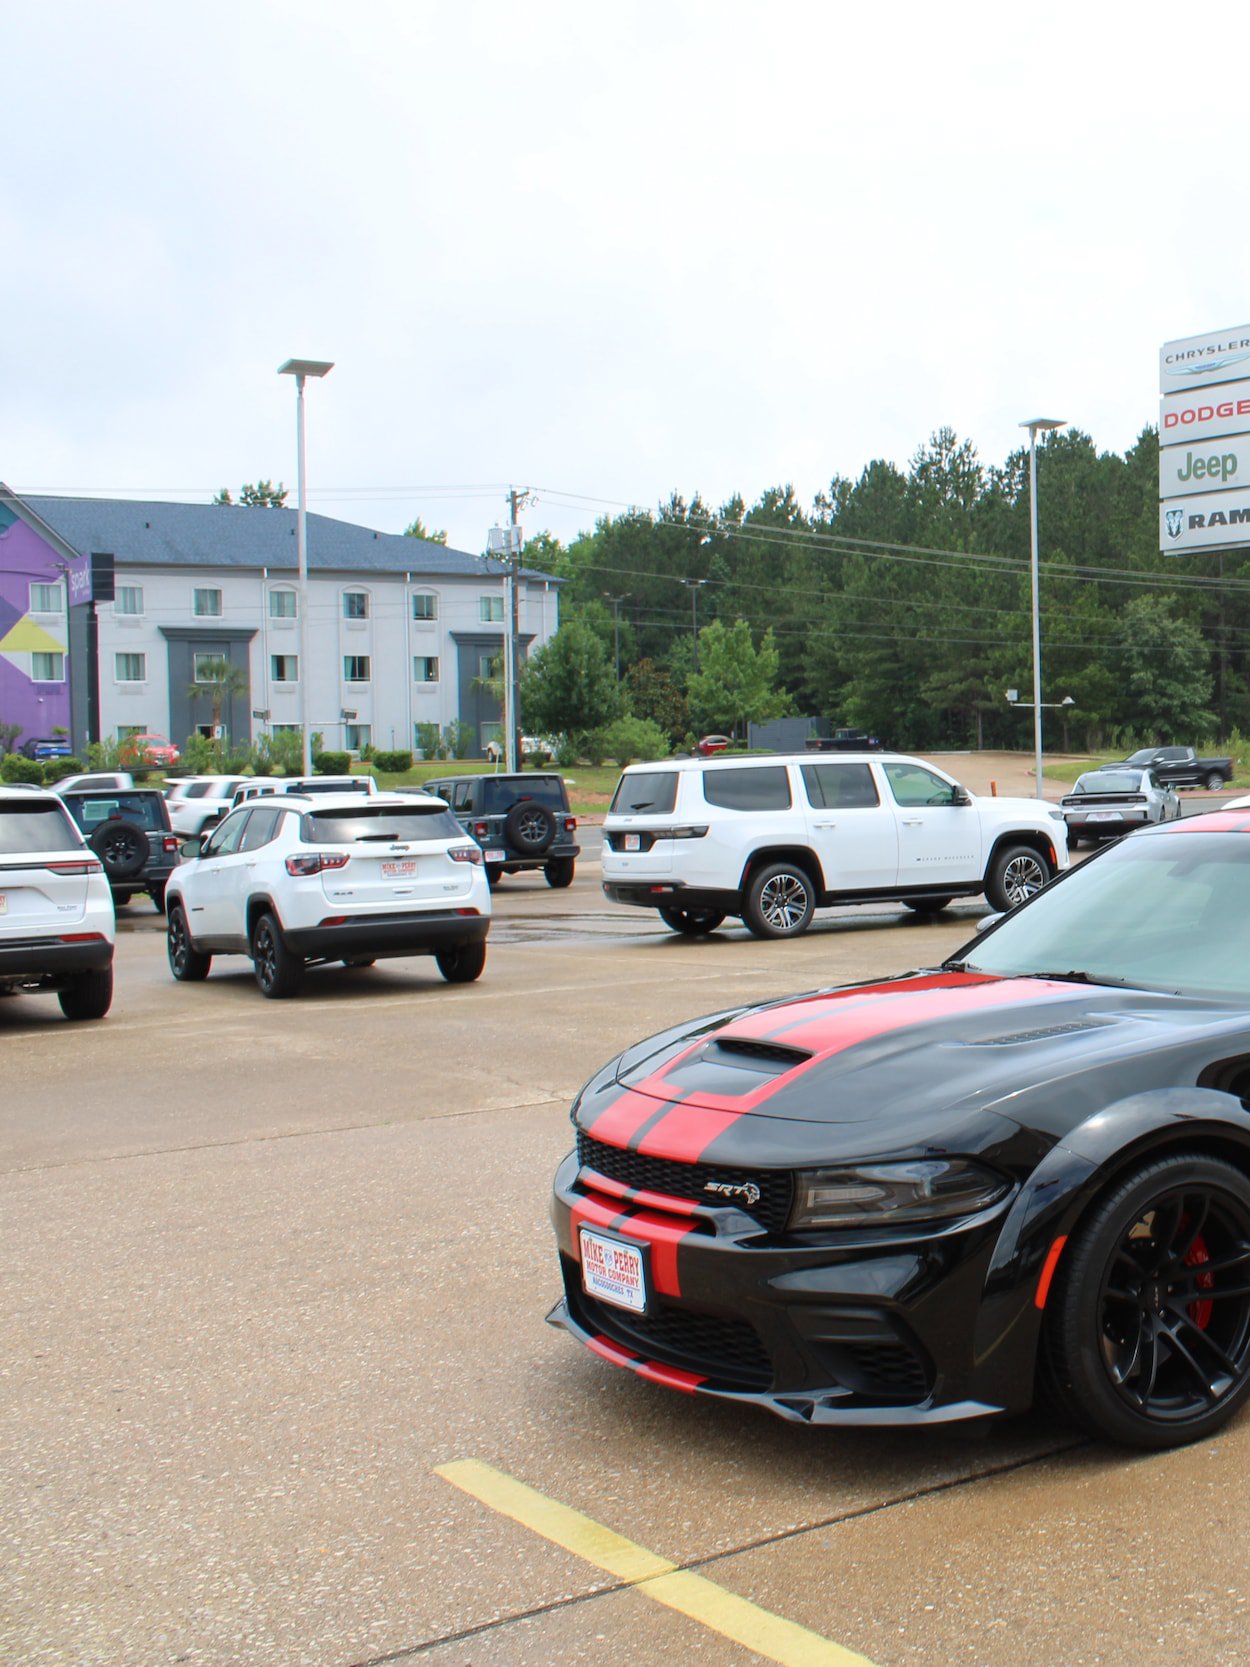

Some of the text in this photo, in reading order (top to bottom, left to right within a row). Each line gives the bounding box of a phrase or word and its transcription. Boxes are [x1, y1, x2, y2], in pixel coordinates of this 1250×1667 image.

[1165, 339, 1250, 364] CHRYSLER
[1177, 452, 1238, 482] Jeep
[703, 1182, 747, 1196] SRT
[583, 1239, 639, 1276] MIKE PERRY
[586, 1260, 639, 1287] MOTOR COMPANY
[626, 1289, 633, 1298] TX
